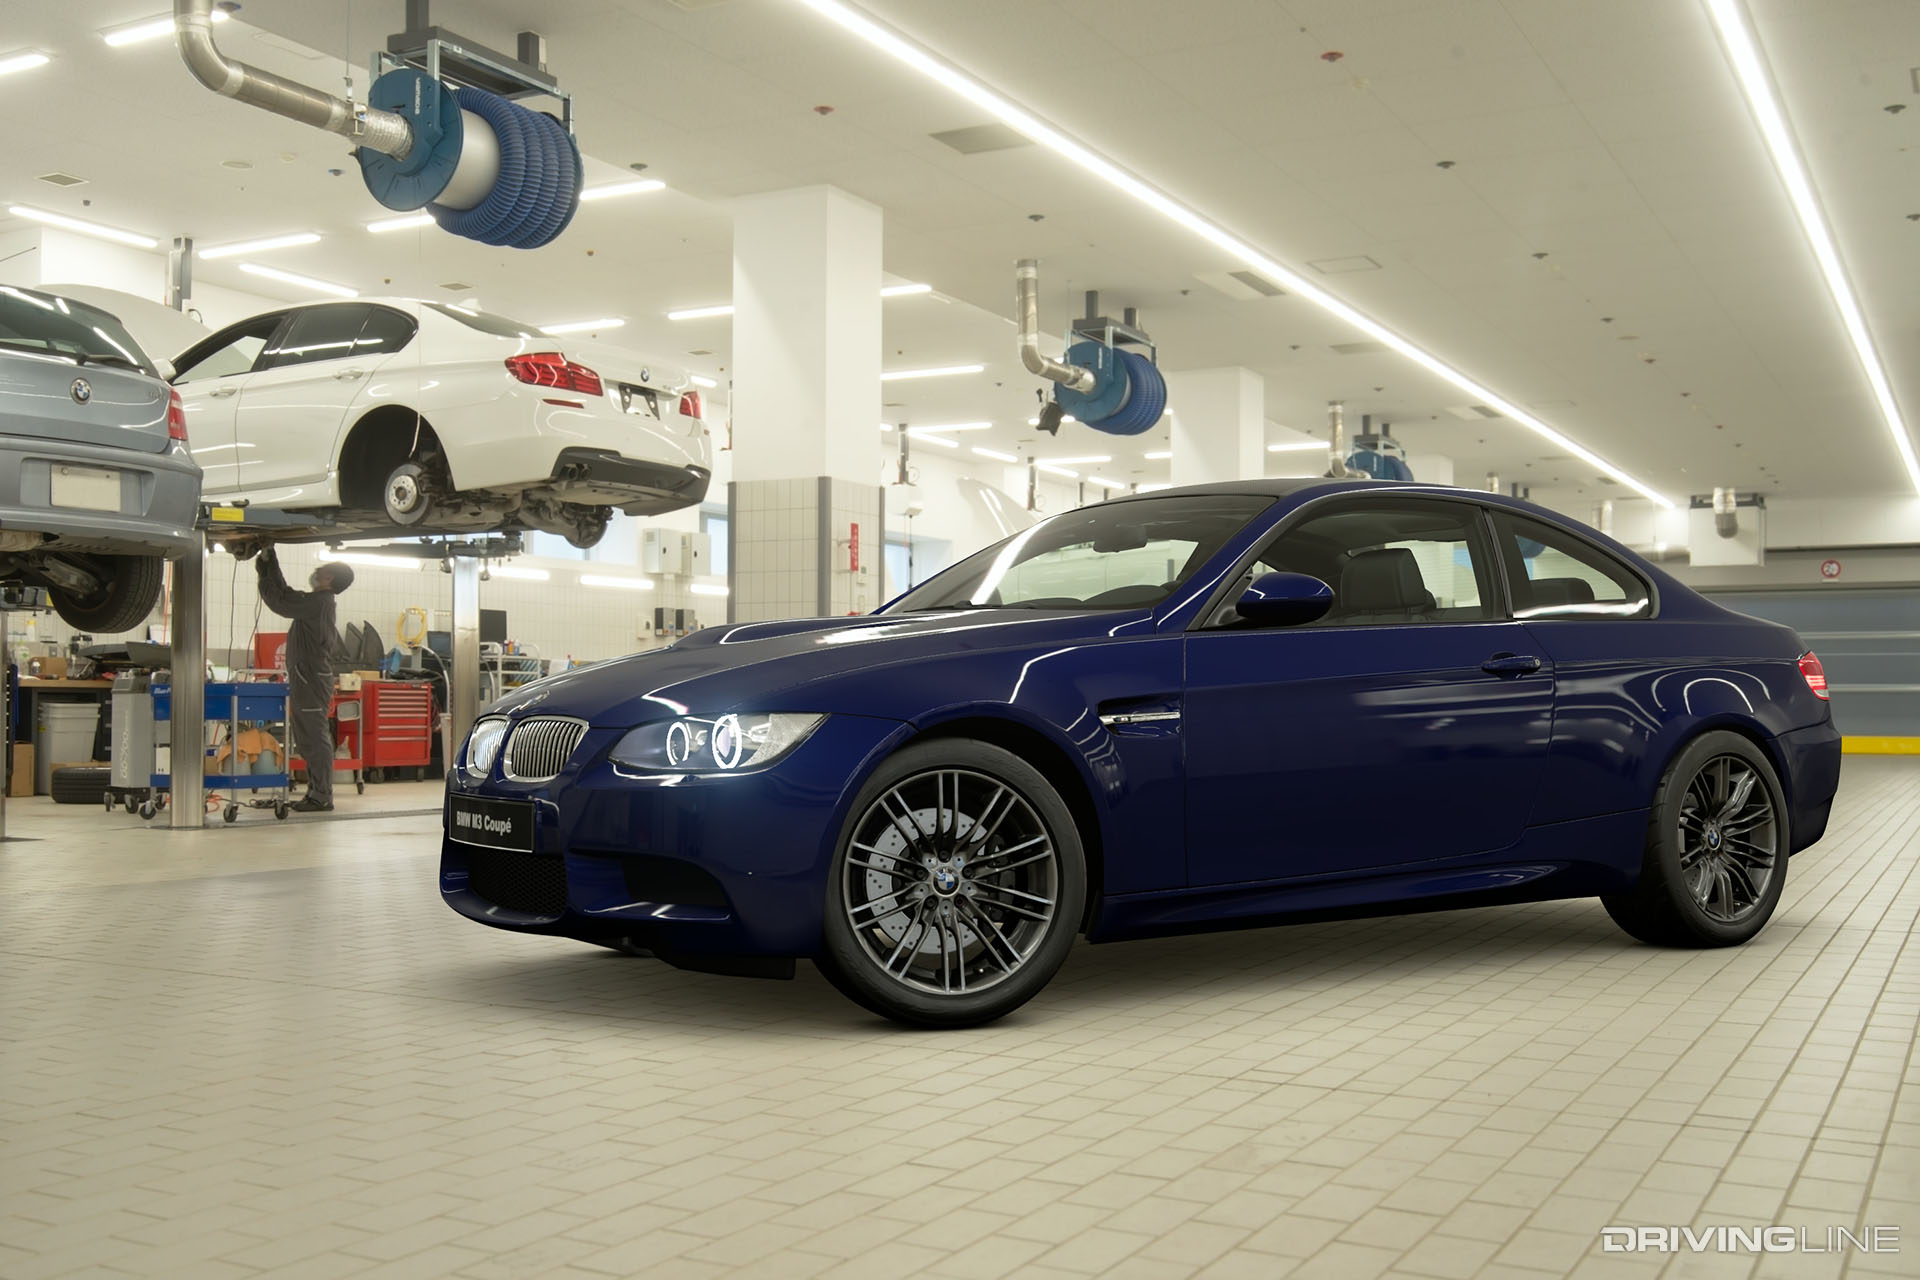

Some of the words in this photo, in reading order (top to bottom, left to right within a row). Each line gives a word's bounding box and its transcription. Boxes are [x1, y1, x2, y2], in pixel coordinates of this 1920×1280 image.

[456, 810, 471, 828] BMW
[472, 813, 483, 830] M3
[484, 815, 512, 836] Coupé
